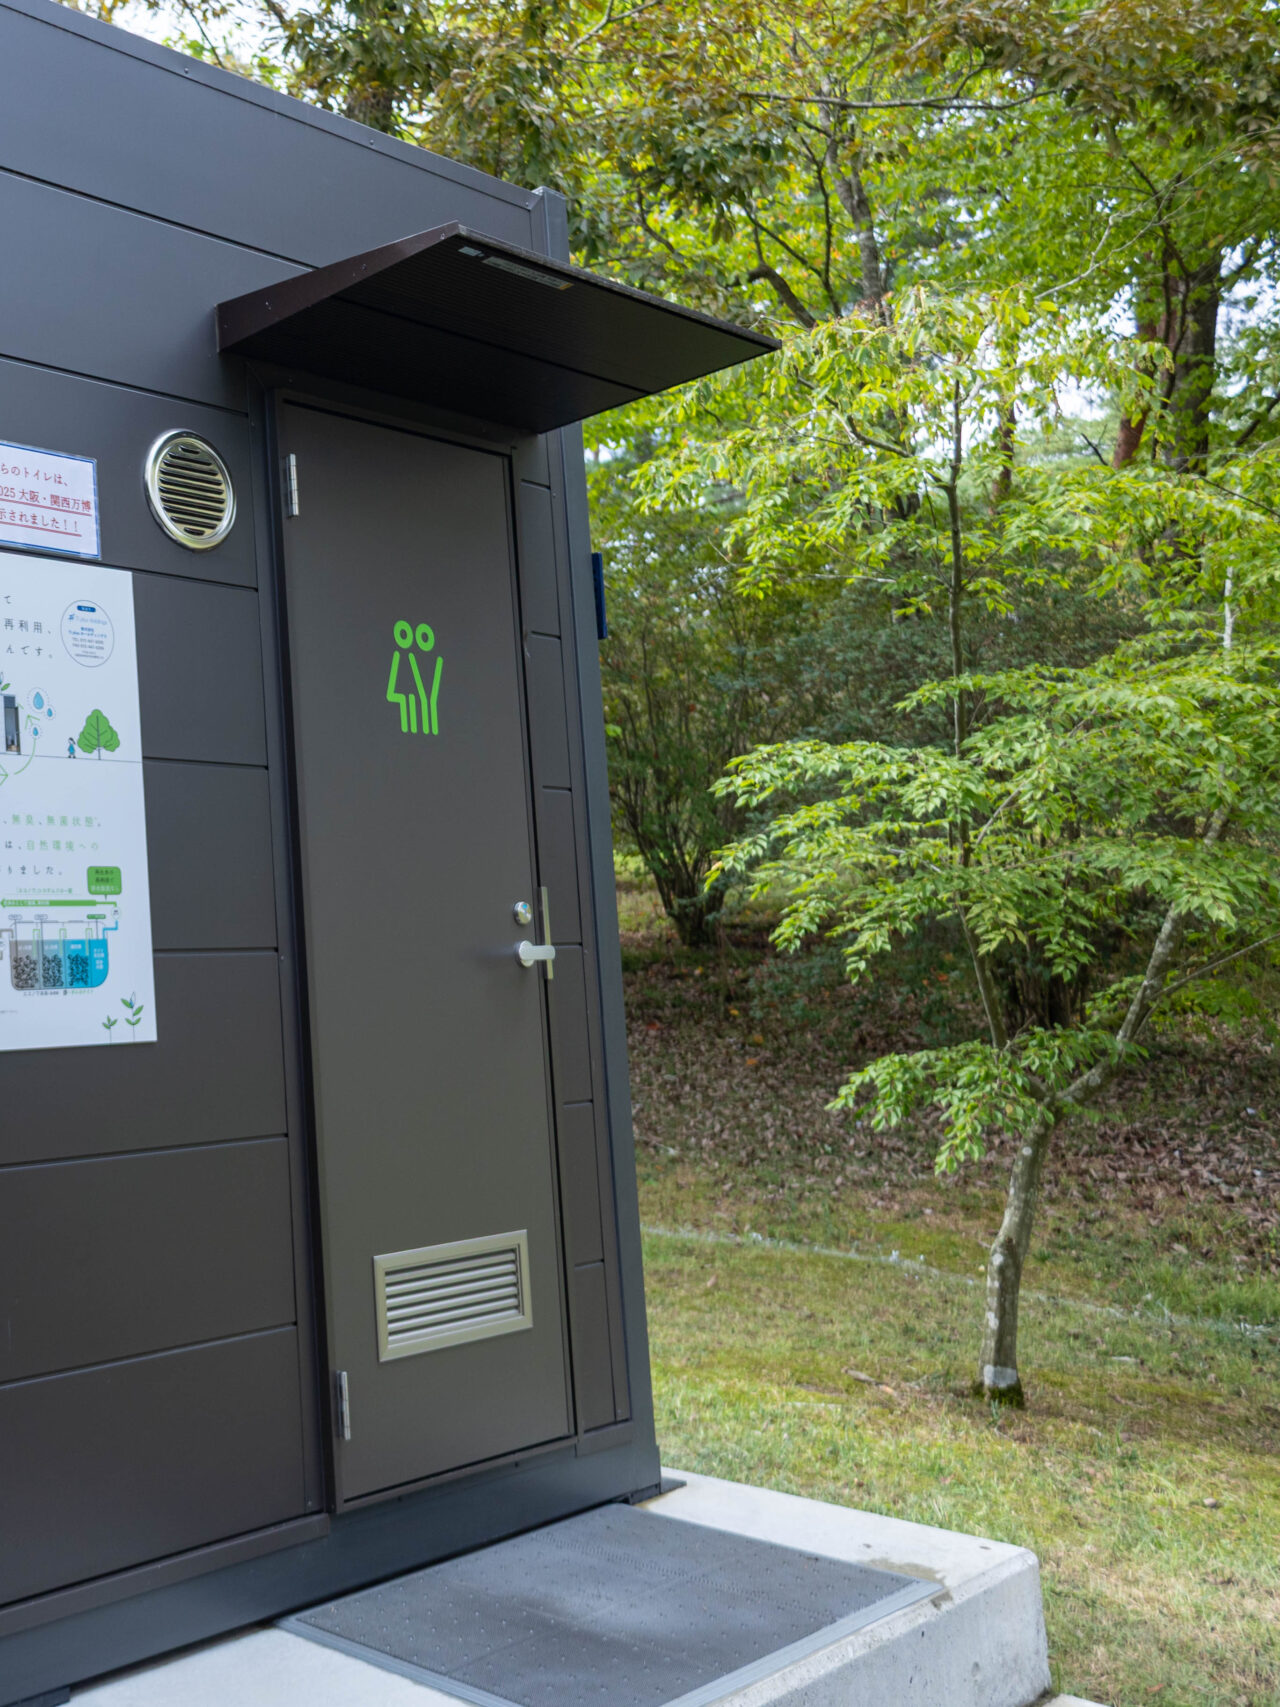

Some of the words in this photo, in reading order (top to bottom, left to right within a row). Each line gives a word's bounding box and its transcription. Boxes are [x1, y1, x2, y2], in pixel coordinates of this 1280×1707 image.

[19, 488, 92, 512] 大阪・関西万博
